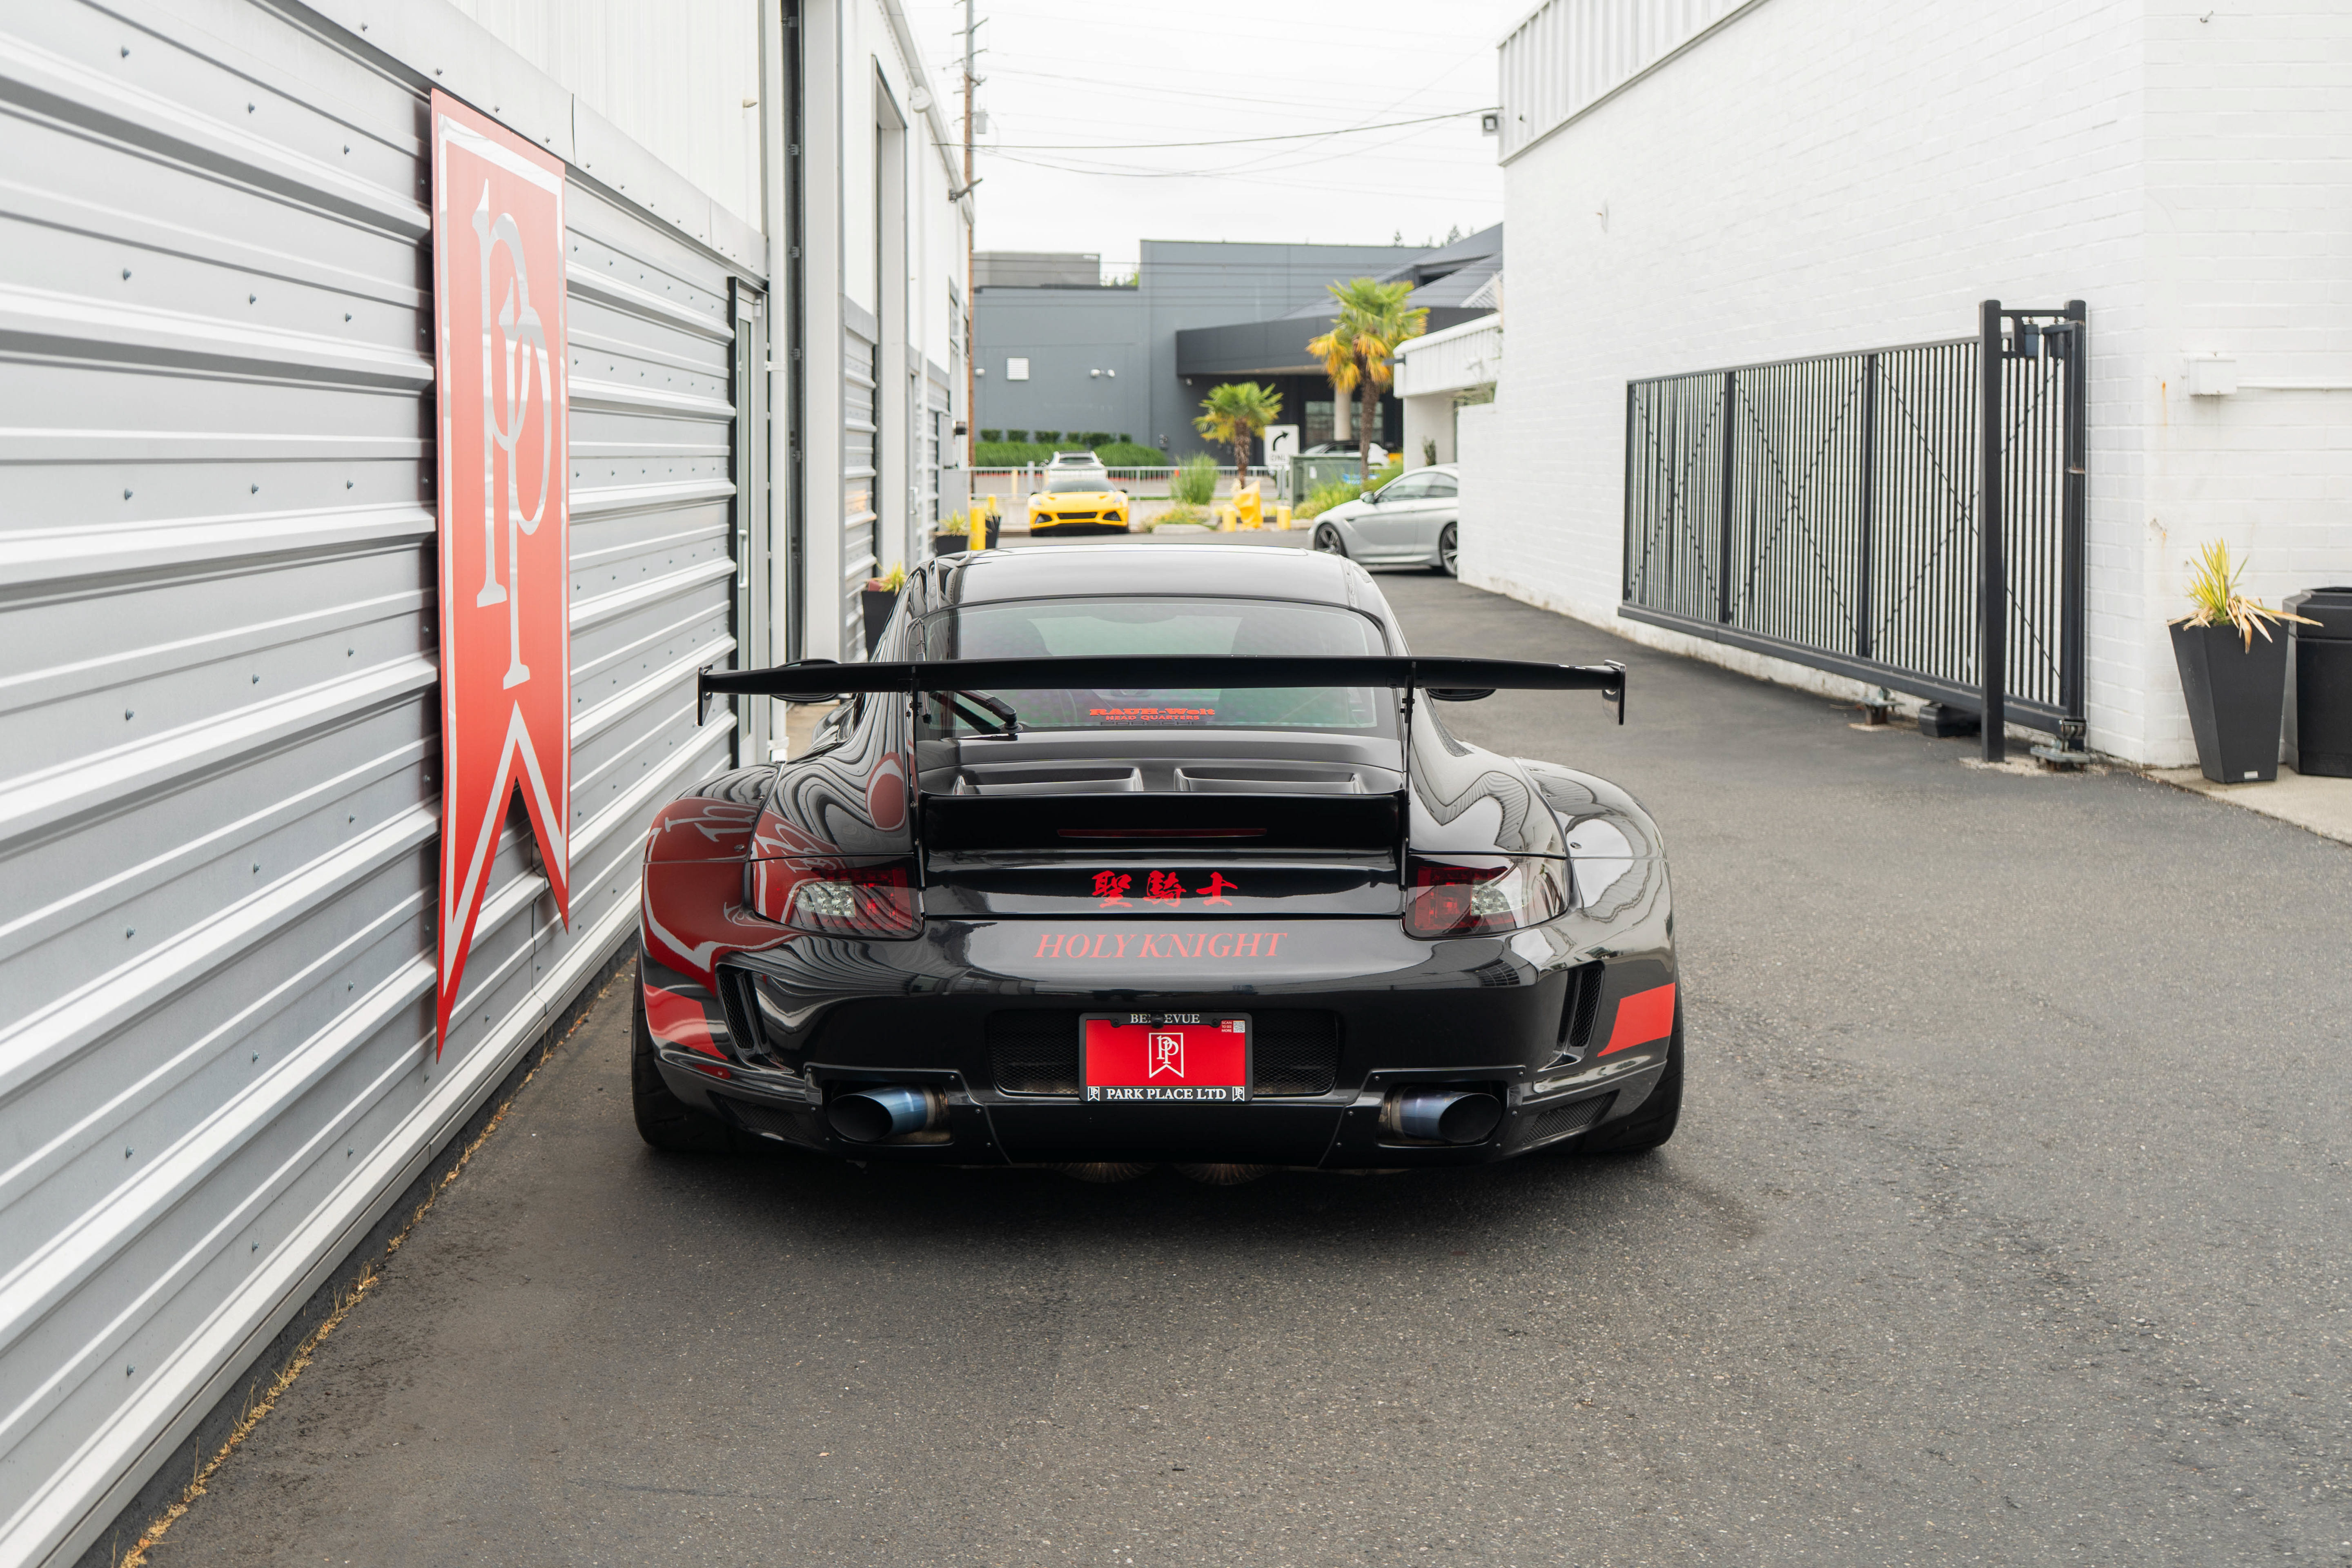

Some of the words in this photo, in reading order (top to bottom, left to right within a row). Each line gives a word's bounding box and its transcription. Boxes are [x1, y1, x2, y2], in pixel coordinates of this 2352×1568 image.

[1091, 870, 1238, 908] 聖騎士
[1033, 934, 1137, 958] HOLY
[1137, 933, 1287, 958] KNIGHT
[1106, 1089, 1144, 1099] PARK
[1147, 1089, 1193, 1099] PLACE
[1196, 1089, 1226, 1099] LTD
